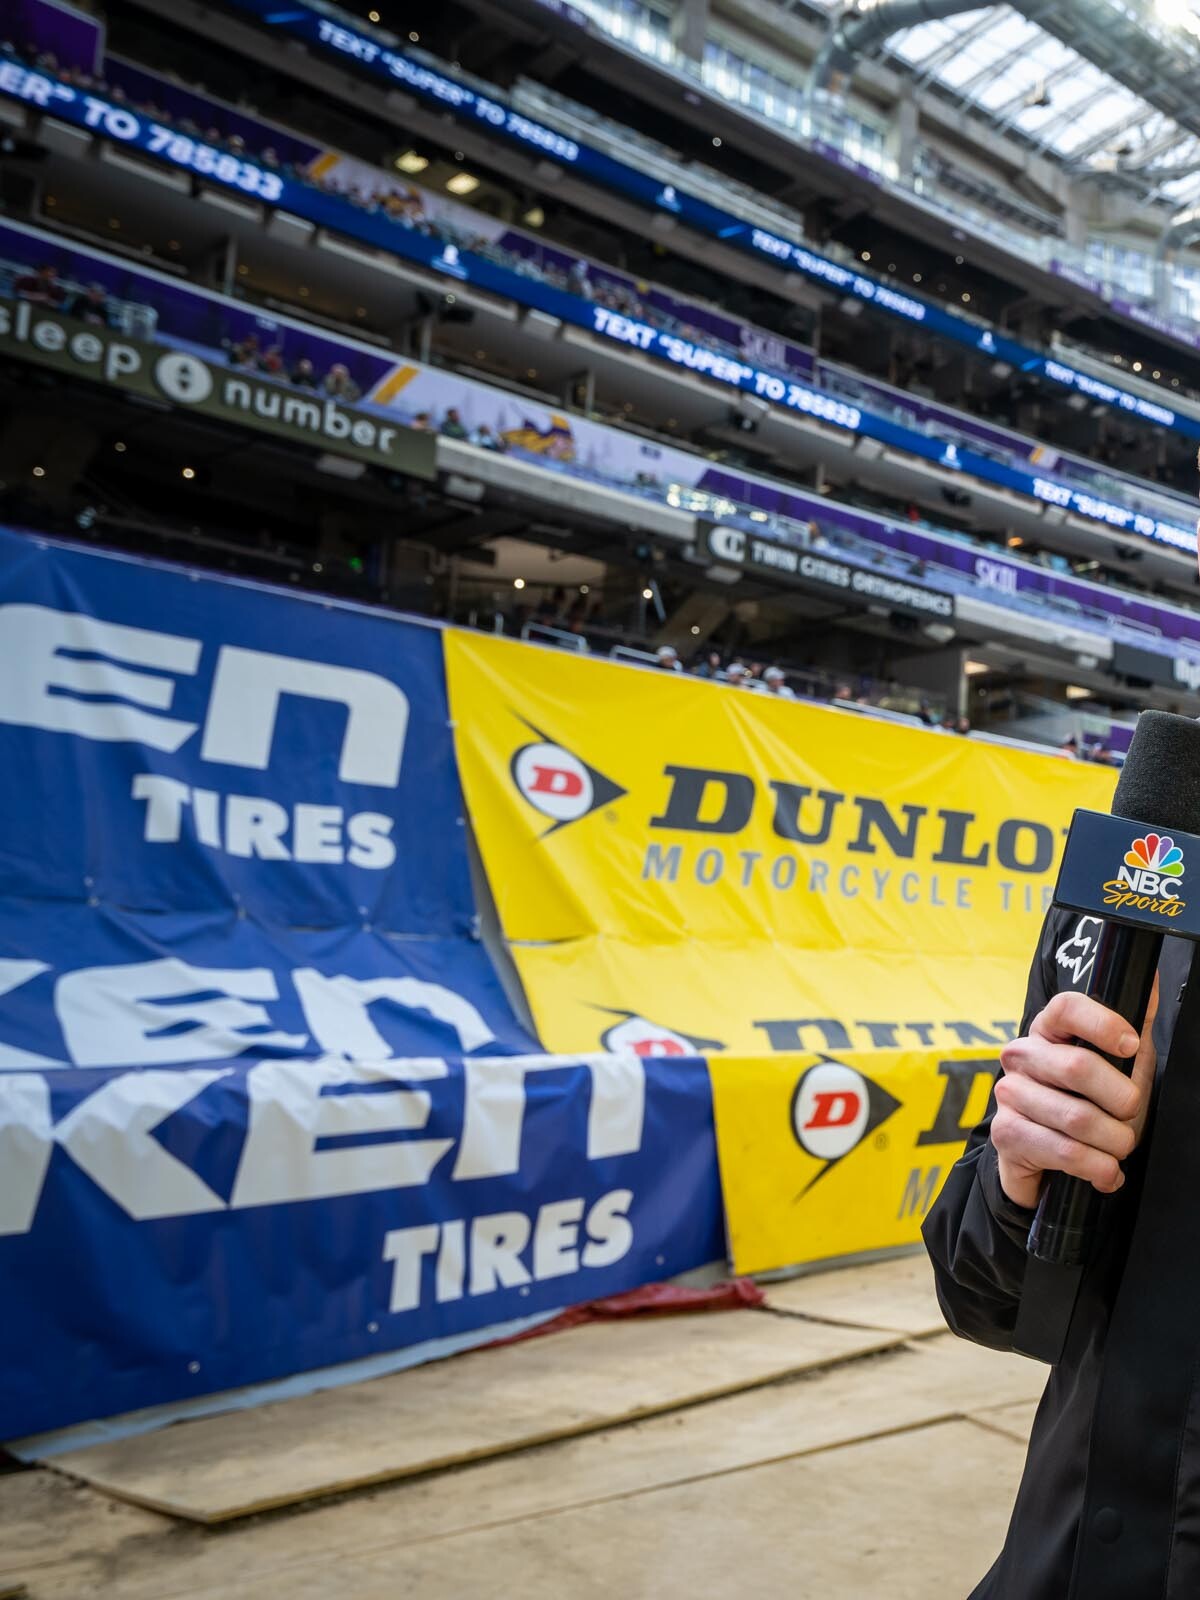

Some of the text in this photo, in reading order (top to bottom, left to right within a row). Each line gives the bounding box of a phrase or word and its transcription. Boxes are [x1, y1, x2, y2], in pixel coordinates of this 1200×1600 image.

[318, 19, 381, 62] TEXT
[475, 97, 506, 125] TO
[83, 96, 141, 140] TO
[148, 124, 284, 201] 785833
[593, 307, 657, 349] TEXT
[755, 372, 785, 400] TO
[224, 378, 397, 454] number
[752, 540, 798, 572] TWIN
[528, 765, 584, 798] D
[649, 765, 1068, 874] DUNLO
[132, 773, 396, 869] TIRES
[642, 843, 972, 907] MOTORCYCLE
[1103, 879, 1186, 917] Sports
[1117, 866, 1183, 899] NBC
[803, 1091, 861, 1131] D
[382, 1189, 634, 1313] TIRES
